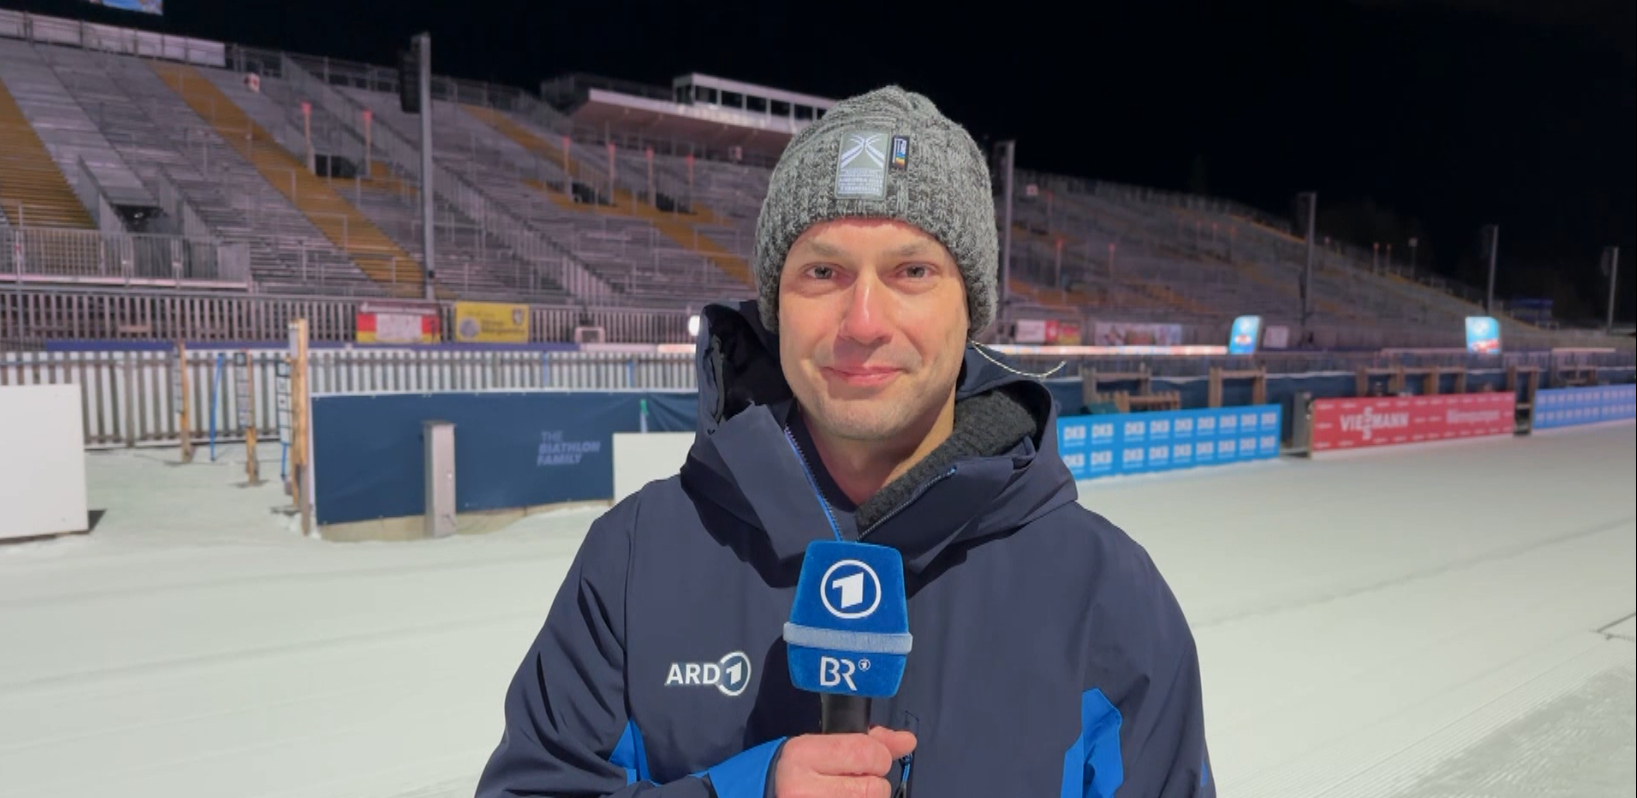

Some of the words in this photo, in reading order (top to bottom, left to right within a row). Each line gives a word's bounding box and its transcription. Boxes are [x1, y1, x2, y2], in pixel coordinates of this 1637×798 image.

[541, 430, 564, 442] THE
[1064, 426, 1085, 439] DKB
[1092, 424, 1113, 437] DKB
[1125, 422, 1144, 435] DKB
[1151, 421, 1169, 432] DKB
[1175, 419, 1192, 431] DKB
[539, 441, 601, 454] BIATHLON
[1091, 451, 1111, 465] DKB
[1124, 449, 1143, 461] DKB
[1150, 447, 1168, 459] DKB
[1175, 445, 1191, 456] DKB
[537, 453, 582, 466] FAMILY
[666, 663, 721, 685] ARD
[819, 655, 858, 691] BR
